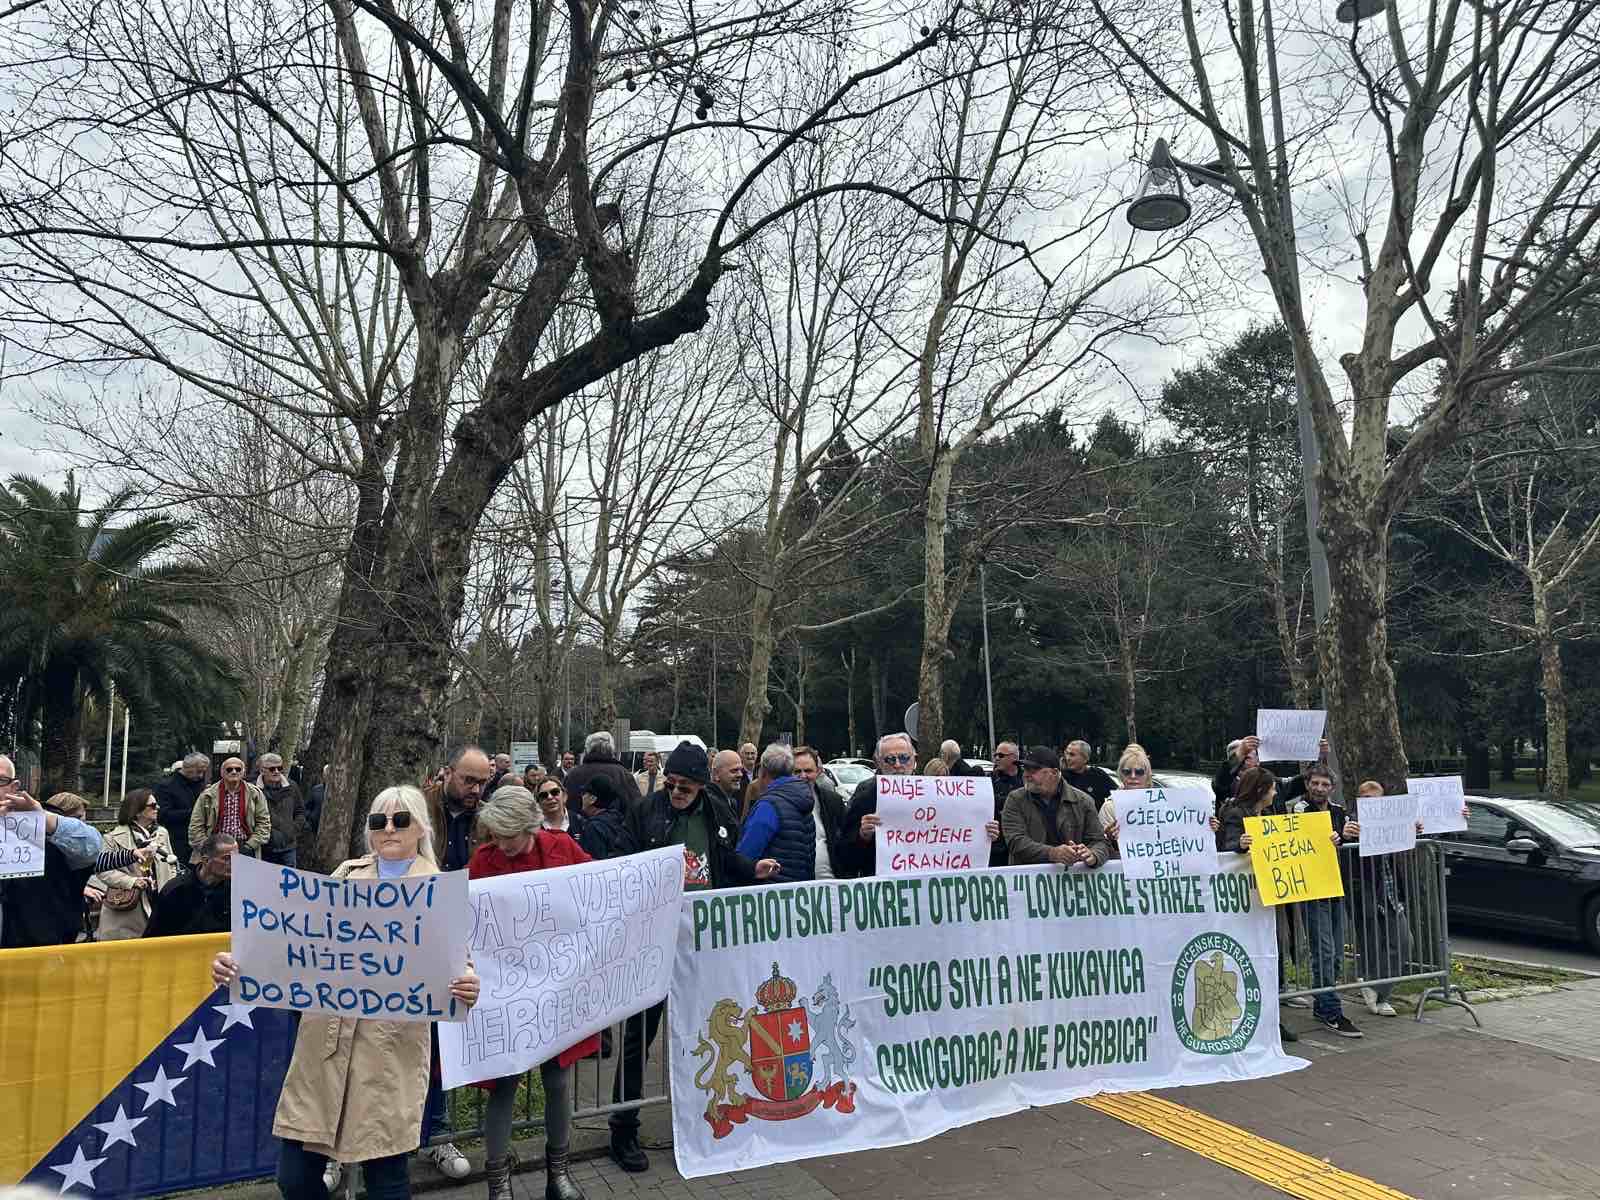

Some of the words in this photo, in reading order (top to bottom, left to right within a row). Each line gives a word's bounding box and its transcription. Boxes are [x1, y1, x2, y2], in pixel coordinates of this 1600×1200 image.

[935, 779, 976, 796] RUKE
[1145, 789, 1167, 803] ZA
[914, 806, 937, 821] OD
[1262, 819, 1279, 835] DA
[1284, 815, 1300, 832] JE
[886, 825, 973, 846] PROMJENE
[1263, 838, 1316, 862] VJEČNA
[513, 882, 557, 941] JE
[692, 886, 833, 951] PATRIOTSKI
[838, 879, 922, 932] POKRET
[927, 873, 1009, 925] OTPORA
[949, 956, 993, 1010] SIVI
[998, 955, 1011, 1005] A
[1017, 953, 1043, 1002] NE
[1047, 947, 1145, 1000] KUKAVICA
[239, 976, 457, 1017] DOBRODOŠLI
[461, 944, 664, 1066] HERCEGOVINA
[876, 1028, 1002, 1095] CRNOGORAC
[1004, 1027, 1018, 1075] A
[1021, 1024, 1049, 1073] NE
[1052, 1015, 1158, 1071] POSRBICA"
